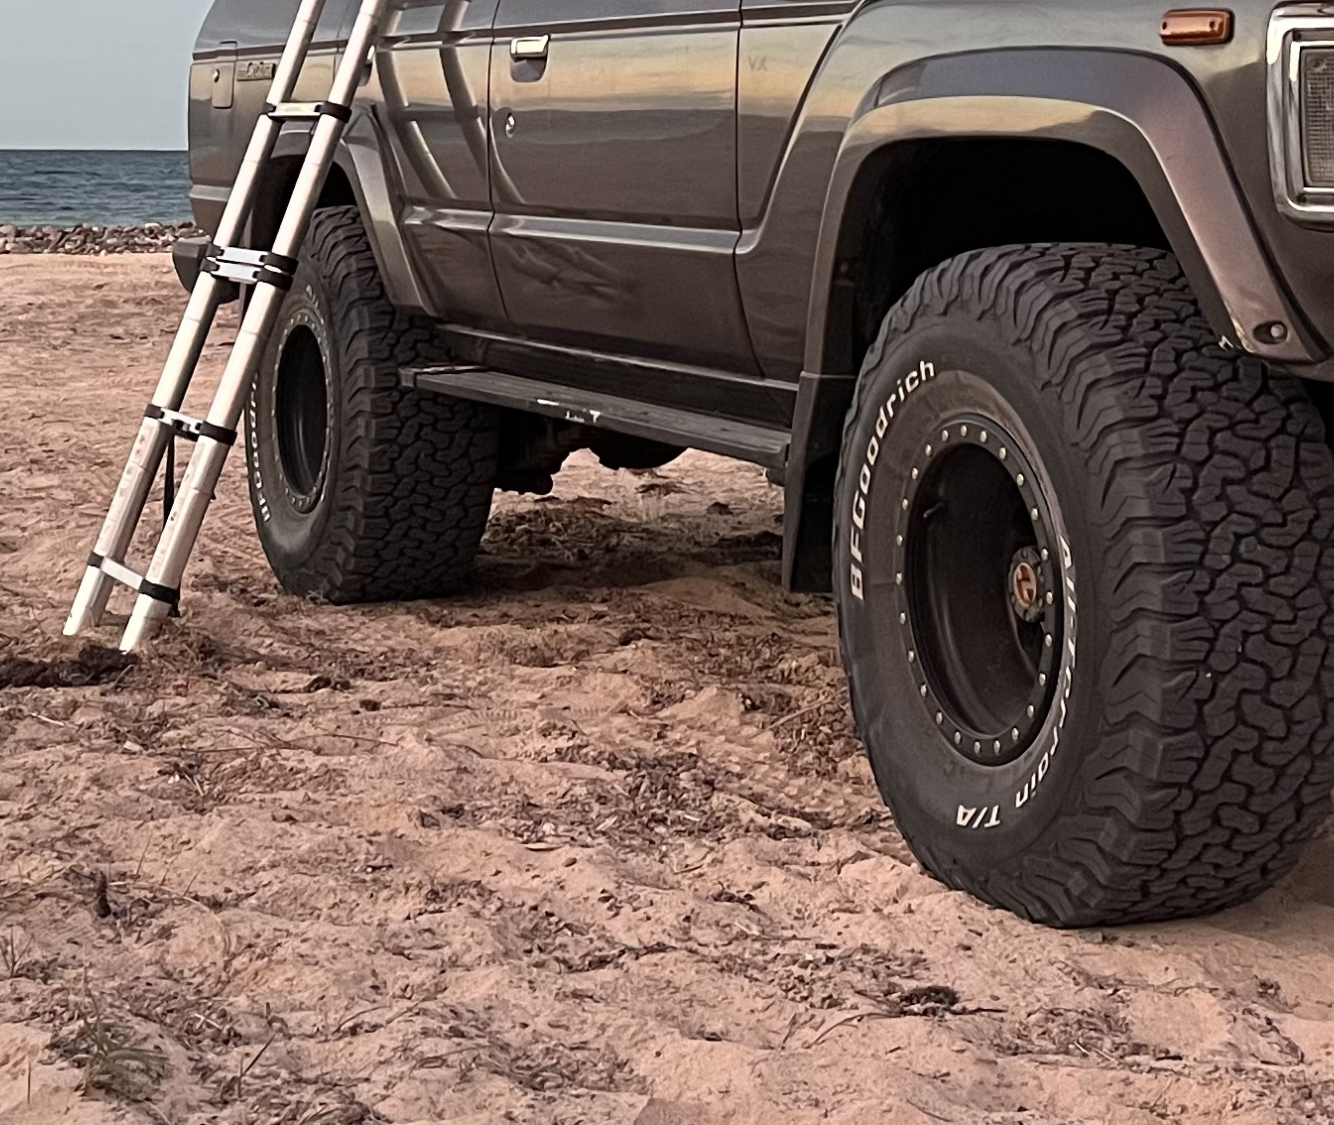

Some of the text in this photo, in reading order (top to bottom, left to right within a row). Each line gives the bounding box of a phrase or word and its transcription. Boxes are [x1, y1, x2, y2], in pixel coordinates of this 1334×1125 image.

[748, 55, 767, 71] VX
[850, 360, 936, 601] BFGoodrich
[956, 804, 1001, 830] T/A
